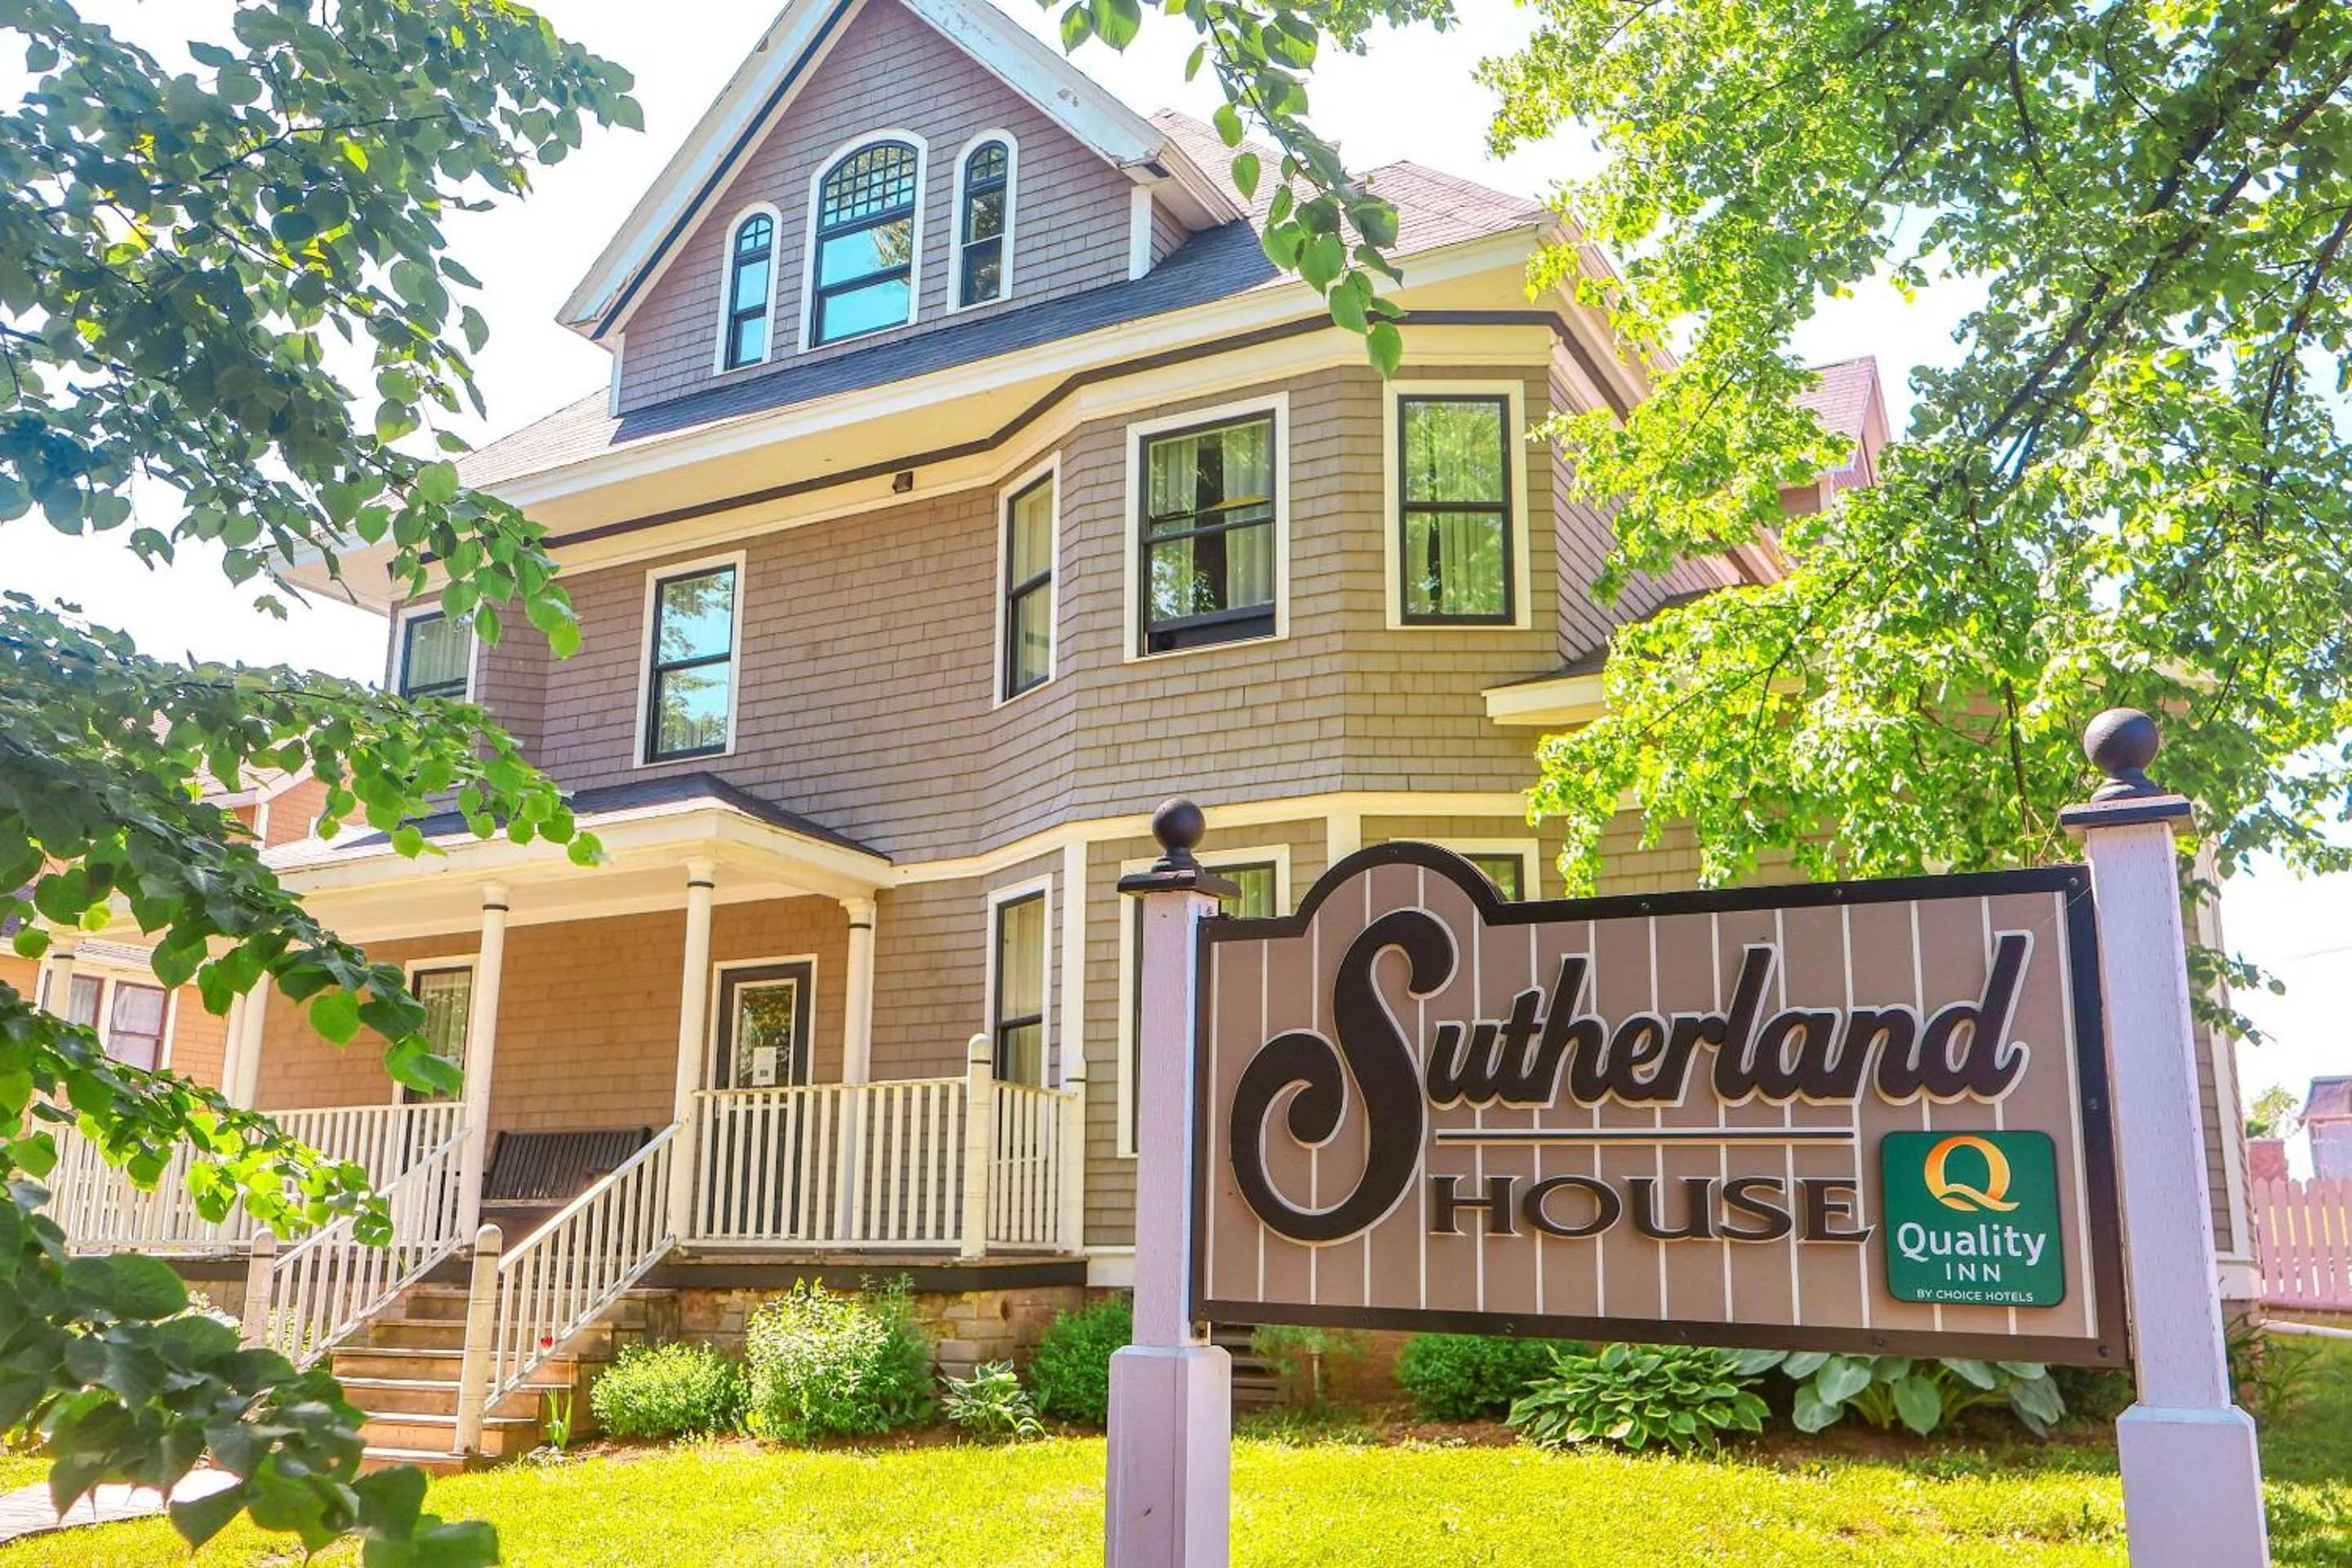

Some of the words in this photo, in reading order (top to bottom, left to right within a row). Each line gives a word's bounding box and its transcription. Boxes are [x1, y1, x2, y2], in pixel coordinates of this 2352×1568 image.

[1231, 906, 2034, 1245] Sutherland
[1428, 1174, 1876, 1244] HOUSE
[1896, 1222, 2047, 1266] Quality
[1945, 1263, 2001, 1282] INN
[1916, 1289, 1933, 1299] BY
[1936, 1290, 1982, 1301] CHOICE
[1985, 1291, 2034, 1302] HOTELS
